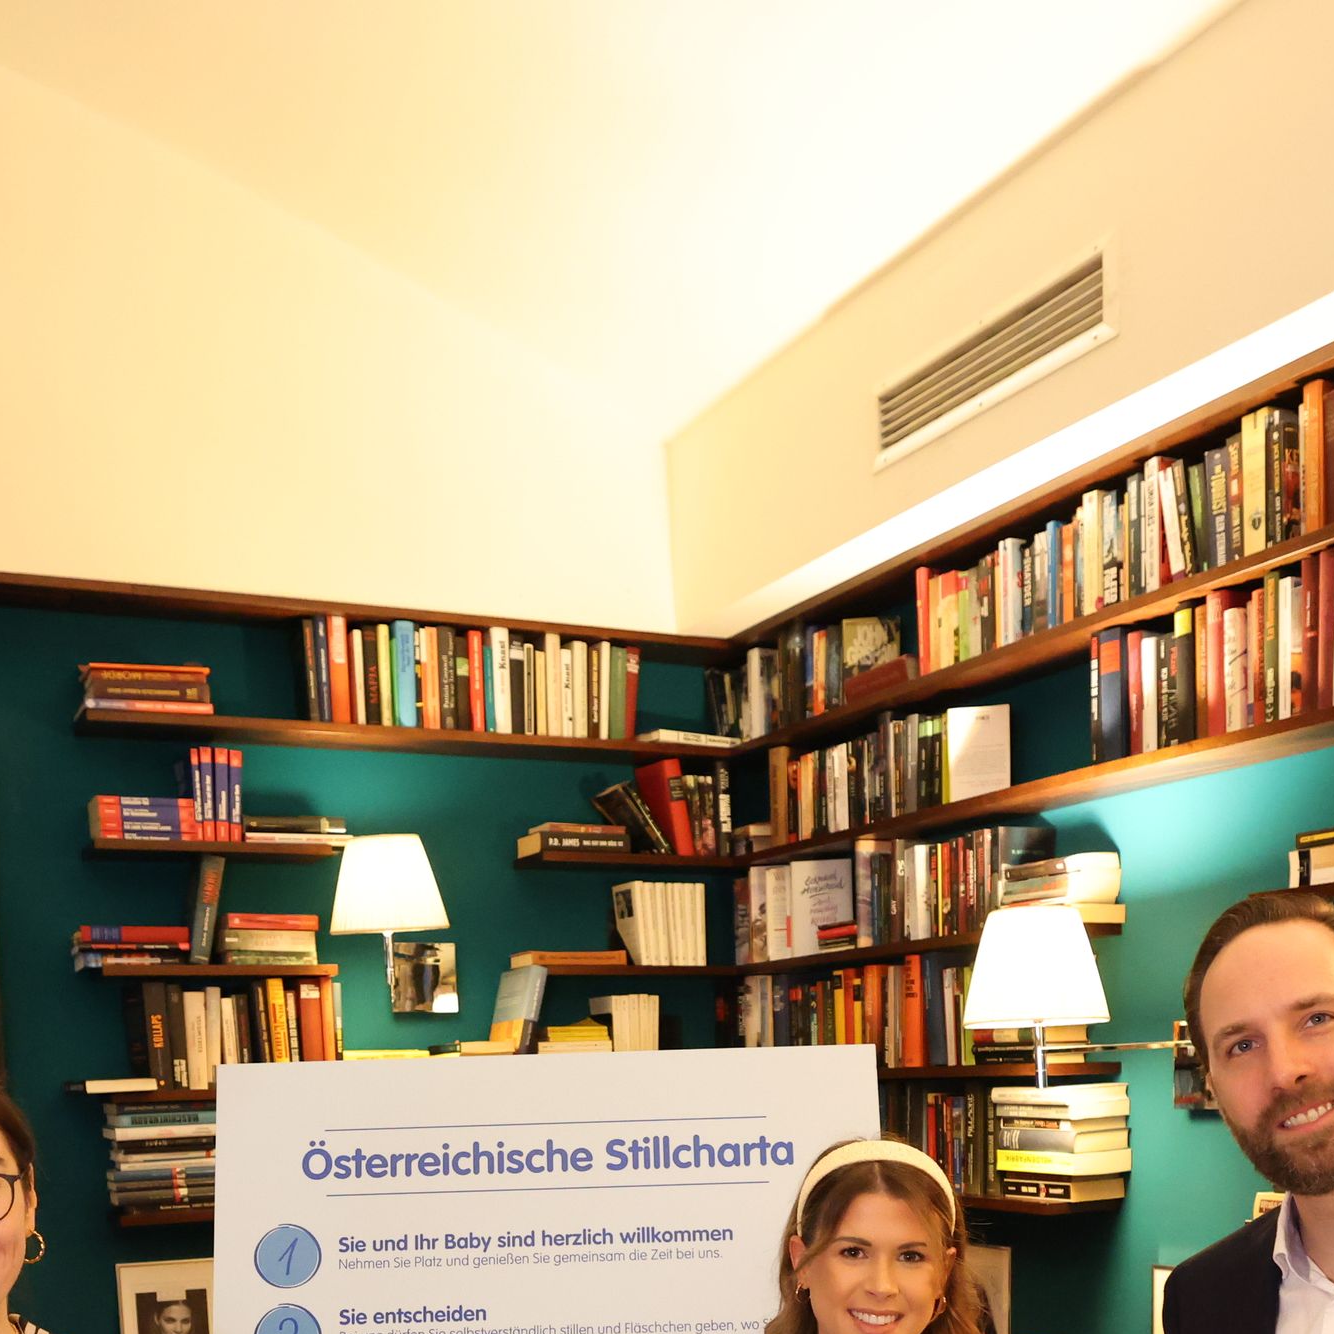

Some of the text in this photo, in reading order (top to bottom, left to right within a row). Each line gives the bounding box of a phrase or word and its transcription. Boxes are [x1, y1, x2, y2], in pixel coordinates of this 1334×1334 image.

[562, 836, 580, 846] JAMES
[153, 1014, 162, 1048] KOLLAPS
[302, 1136, 793, 1178] Österreichische Stillcharta
[339, 1227, 732, 1253] Sie und Ihr Baby sind herzlich willkommen
[277, 1236, 300, 1276] 1
[338, 1248, 722, 1269] Nehmen Sie Platz und genießen Sie gemeinsam die Zeit bei uns.
[339, 1305, 486, 1324] Sie entscheiden
